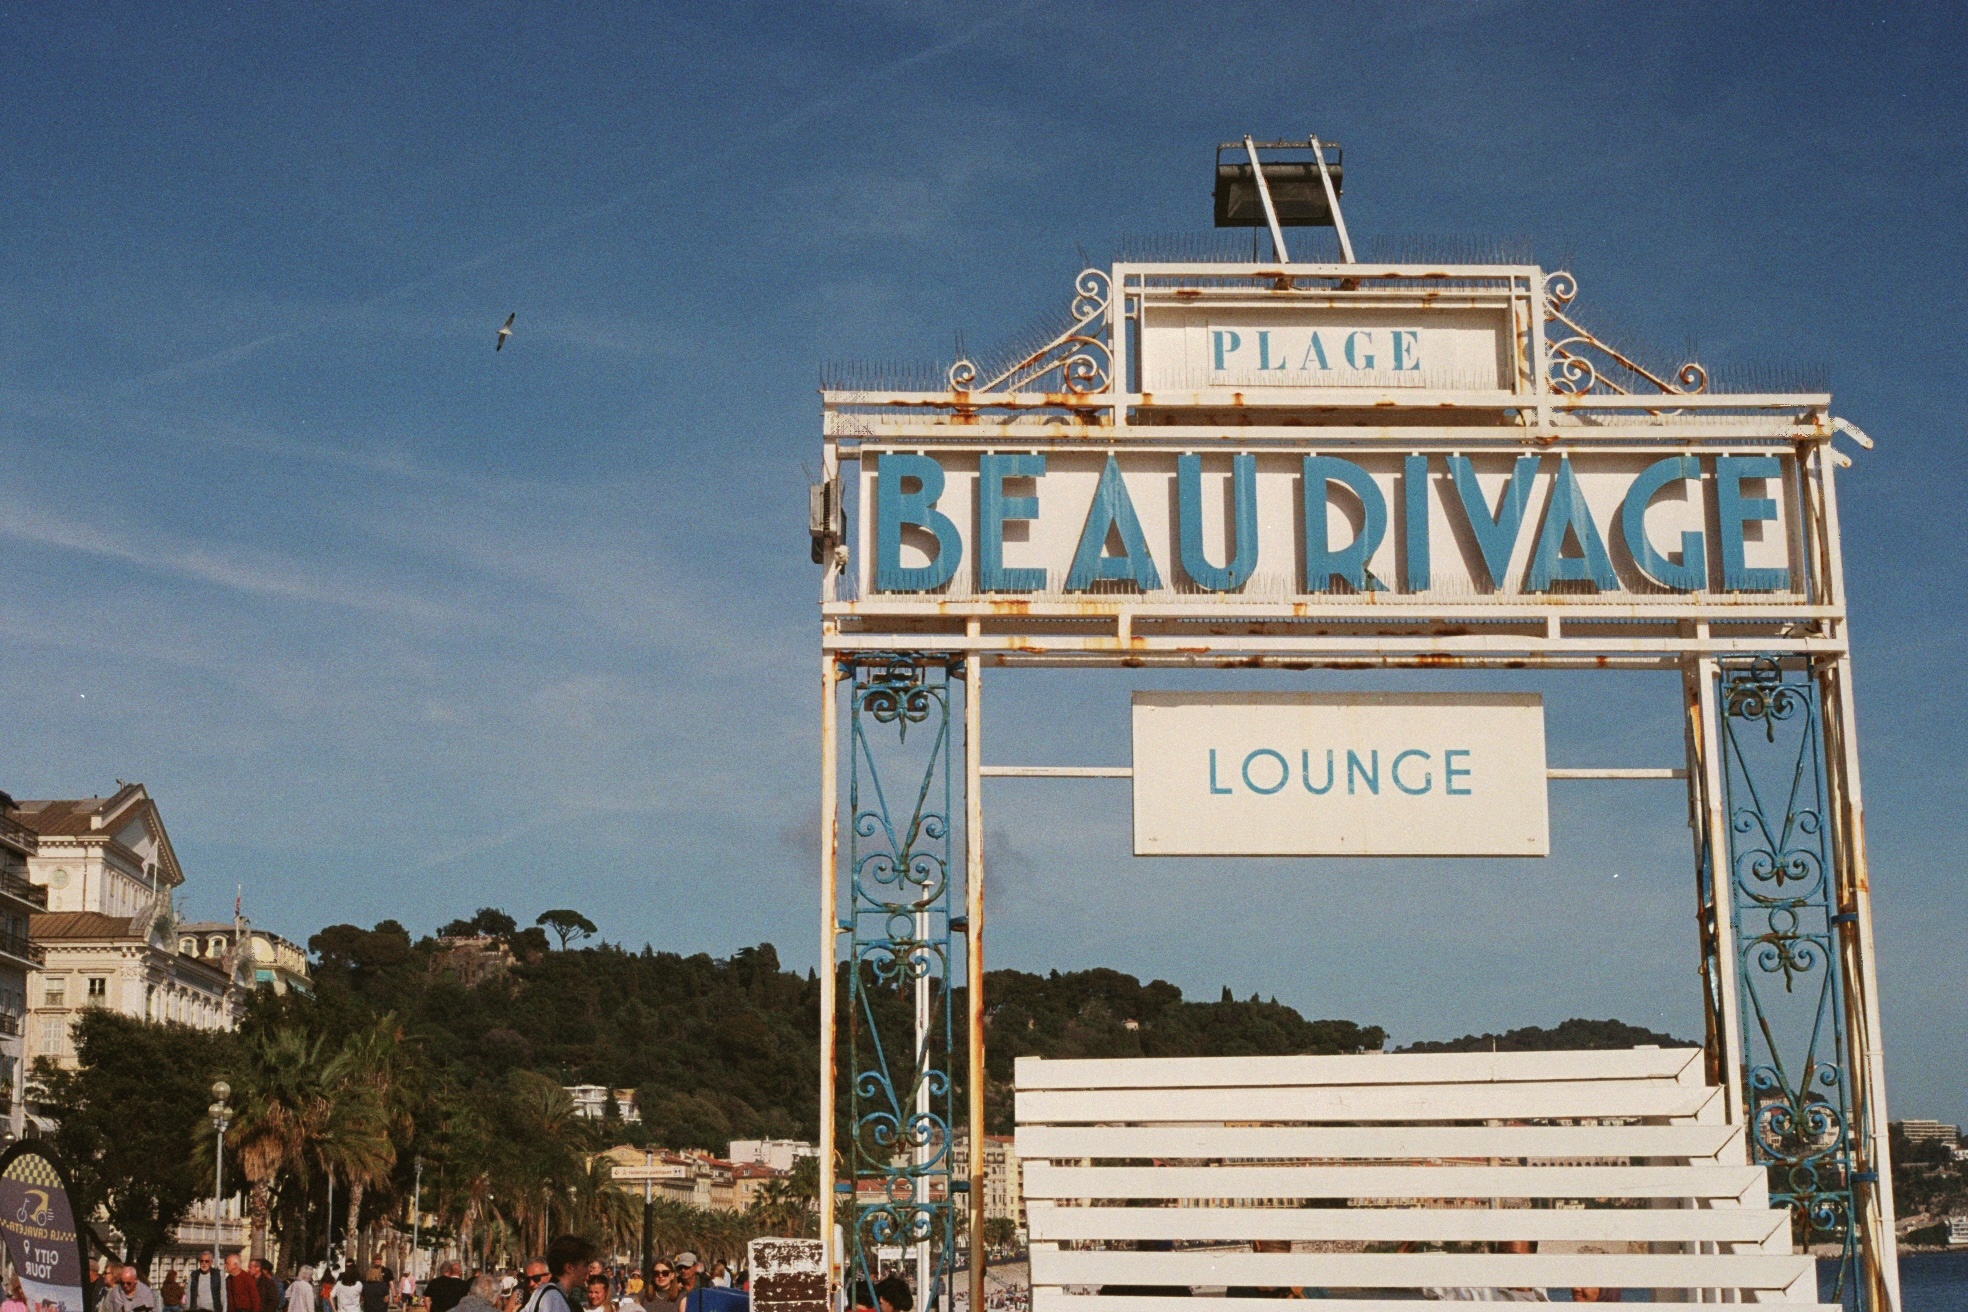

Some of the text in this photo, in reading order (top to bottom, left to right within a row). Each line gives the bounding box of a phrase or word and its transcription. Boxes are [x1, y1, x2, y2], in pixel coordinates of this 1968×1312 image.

[1211, 330, 1422, 372] PLAGE
[877, 453, 1791, 592] BEAU RIVAGE
[1209, 748, 1472, 796] LOUNGE
